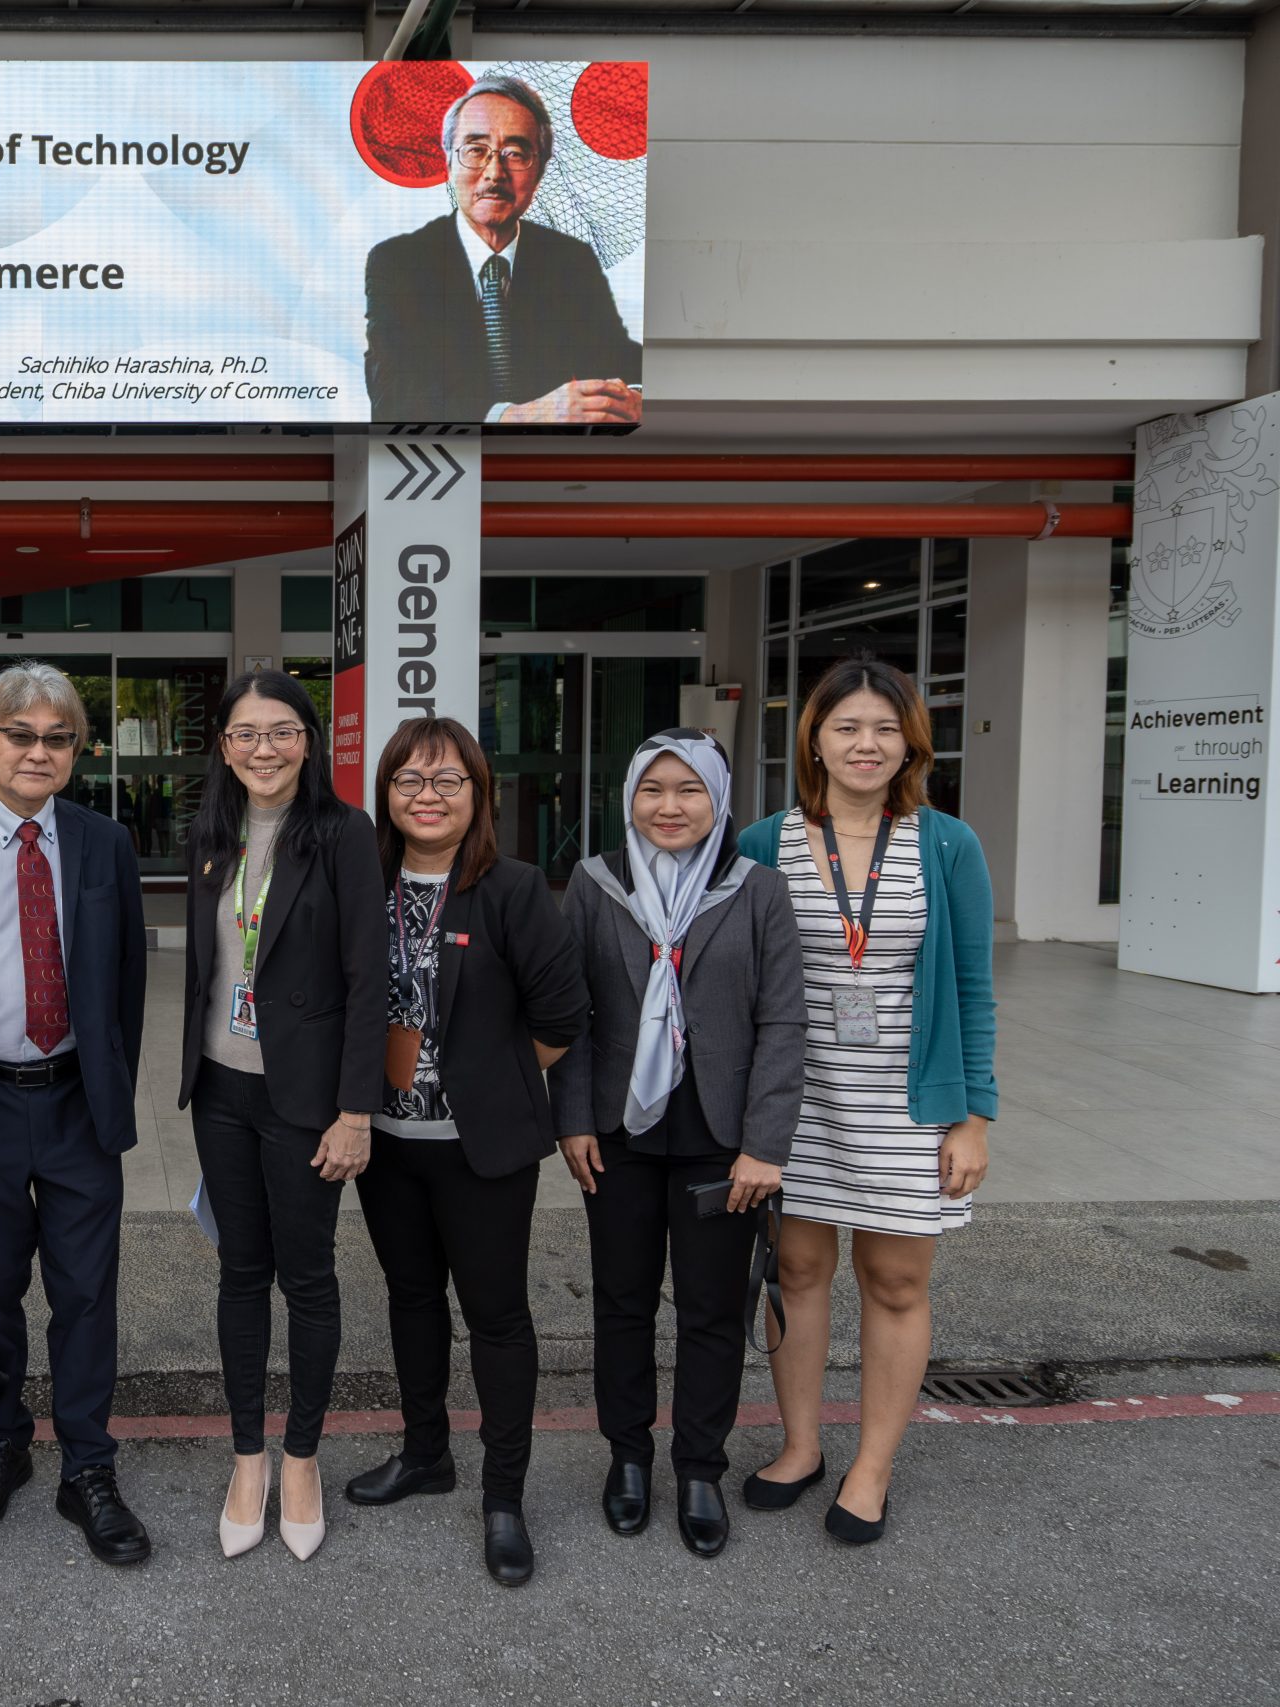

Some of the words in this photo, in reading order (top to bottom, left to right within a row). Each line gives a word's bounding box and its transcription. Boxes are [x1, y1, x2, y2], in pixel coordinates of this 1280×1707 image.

[32, 134, 249, 175] Technology
[18, 356, 109, 374] Sachihiko
[114, 357, 214, 376] Harashina,
[220, 356, 268, 374] Ph.D.
[52, 382, 106, 400] Chiba
[112, 382, 206, 404] University
[210, 382, 234, 400] of
[235, 383, 339, 400] Commerce
[338, 573, 361, 621] BUR
[397, 544, 451, 729] Gener
[1163, 626, 1181, 635] PER
[1129, 705, 1264, 730] Achievement
[1194, 737, 1263, 759] through
[1157, 771, 1261, 801] Learning
